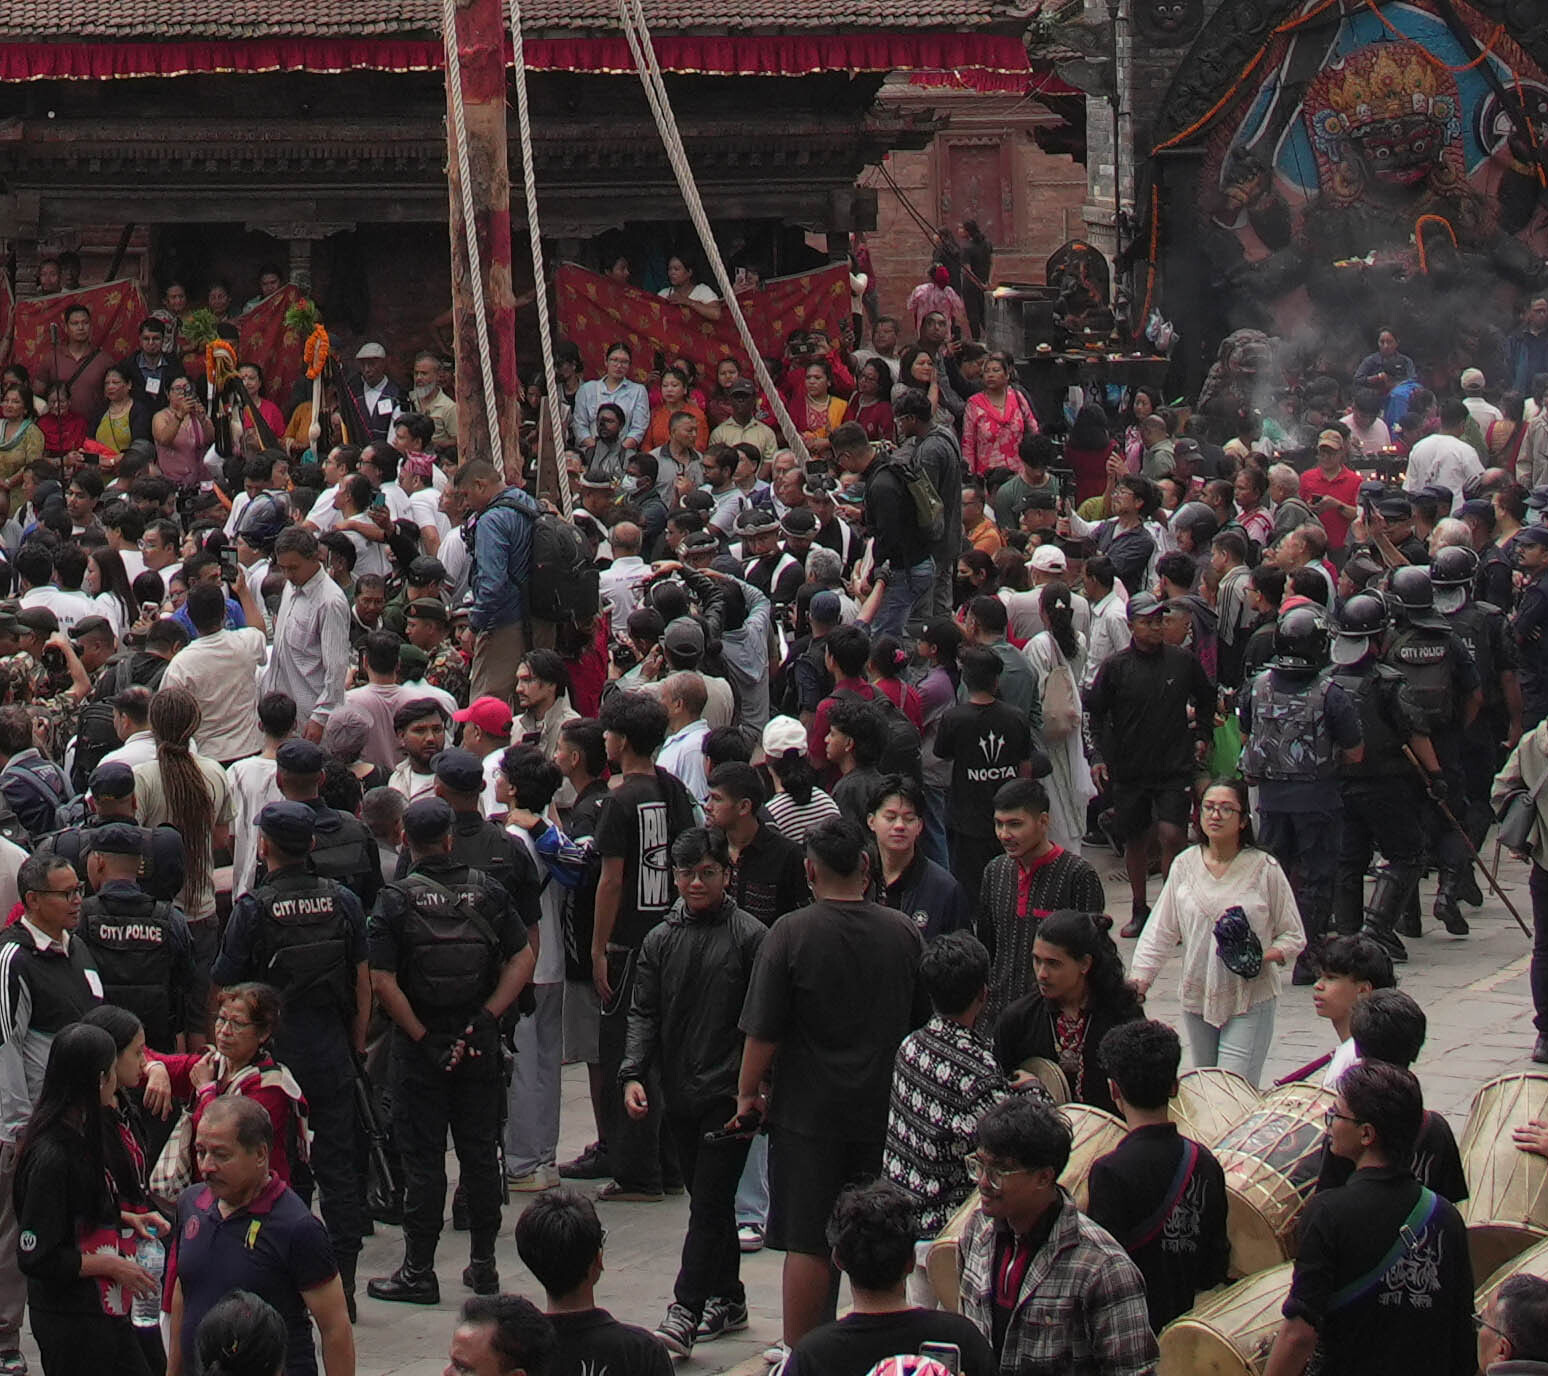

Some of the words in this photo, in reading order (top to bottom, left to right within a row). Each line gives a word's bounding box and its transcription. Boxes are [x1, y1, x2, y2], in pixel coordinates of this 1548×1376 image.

[272, 901, 296, 917] CITY
[298, 897, 333, 914] POLICE
[99, 924, 123, 941] CITY
[125, 924, 162, 942] POLICE
